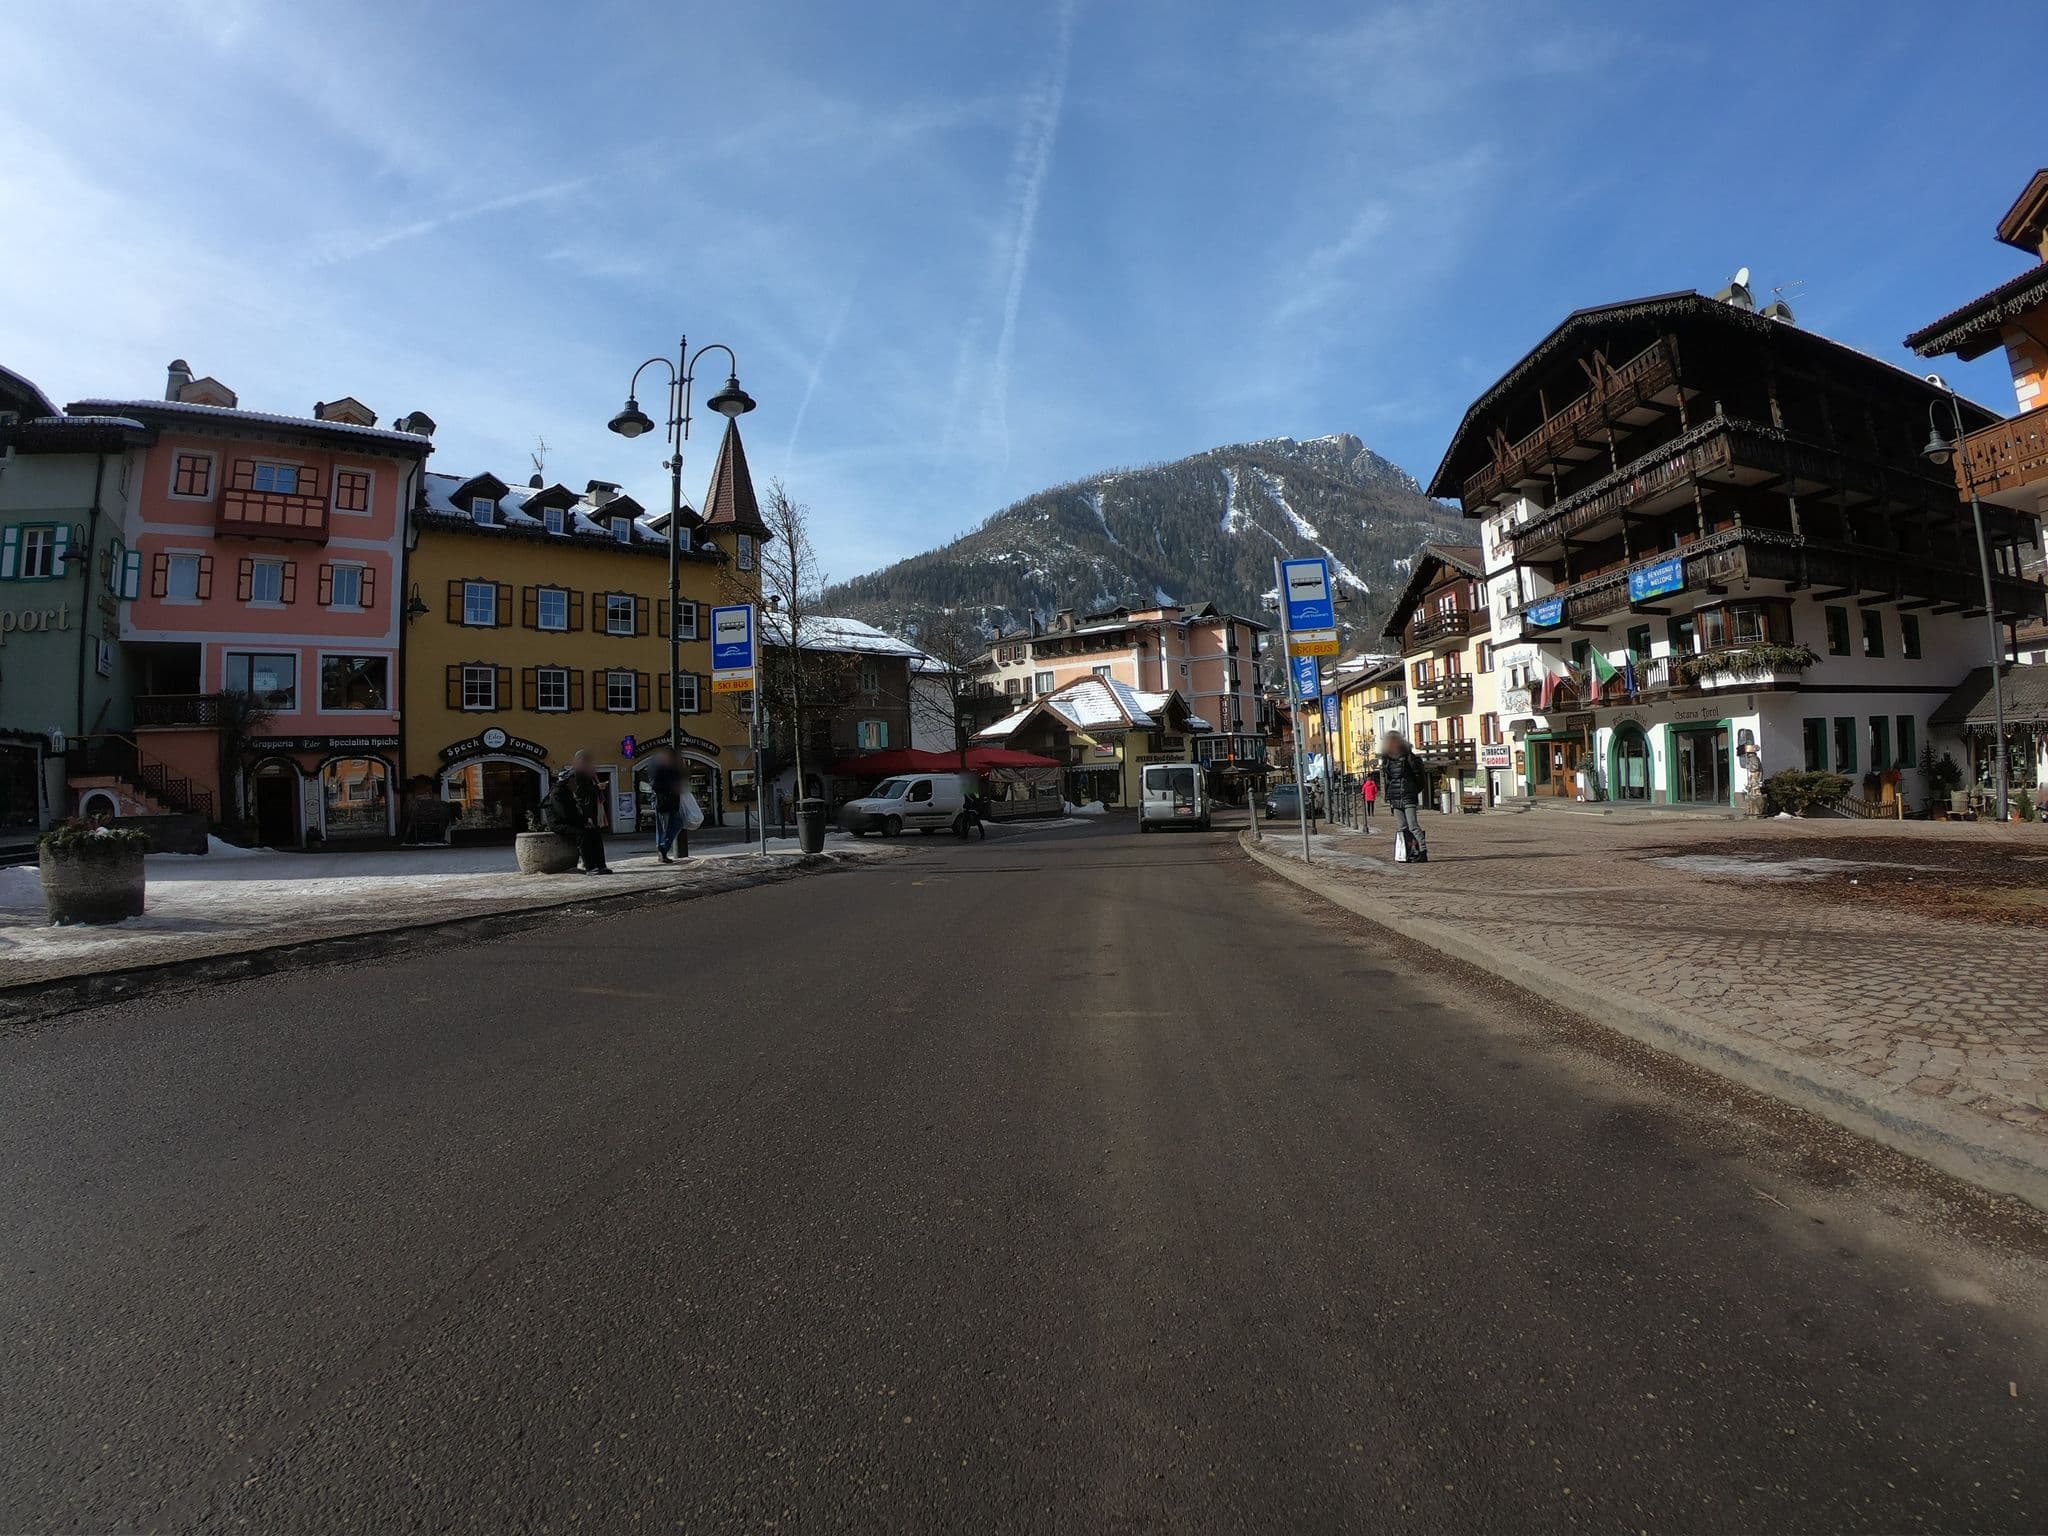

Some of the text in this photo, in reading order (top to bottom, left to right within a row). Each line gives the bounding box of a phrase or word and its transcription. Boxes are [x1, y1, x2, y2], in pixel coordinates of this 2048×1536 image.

[1296, 643, 1334, 655] SKI BUS
[718, 680, 749, 690] SKI BUS
